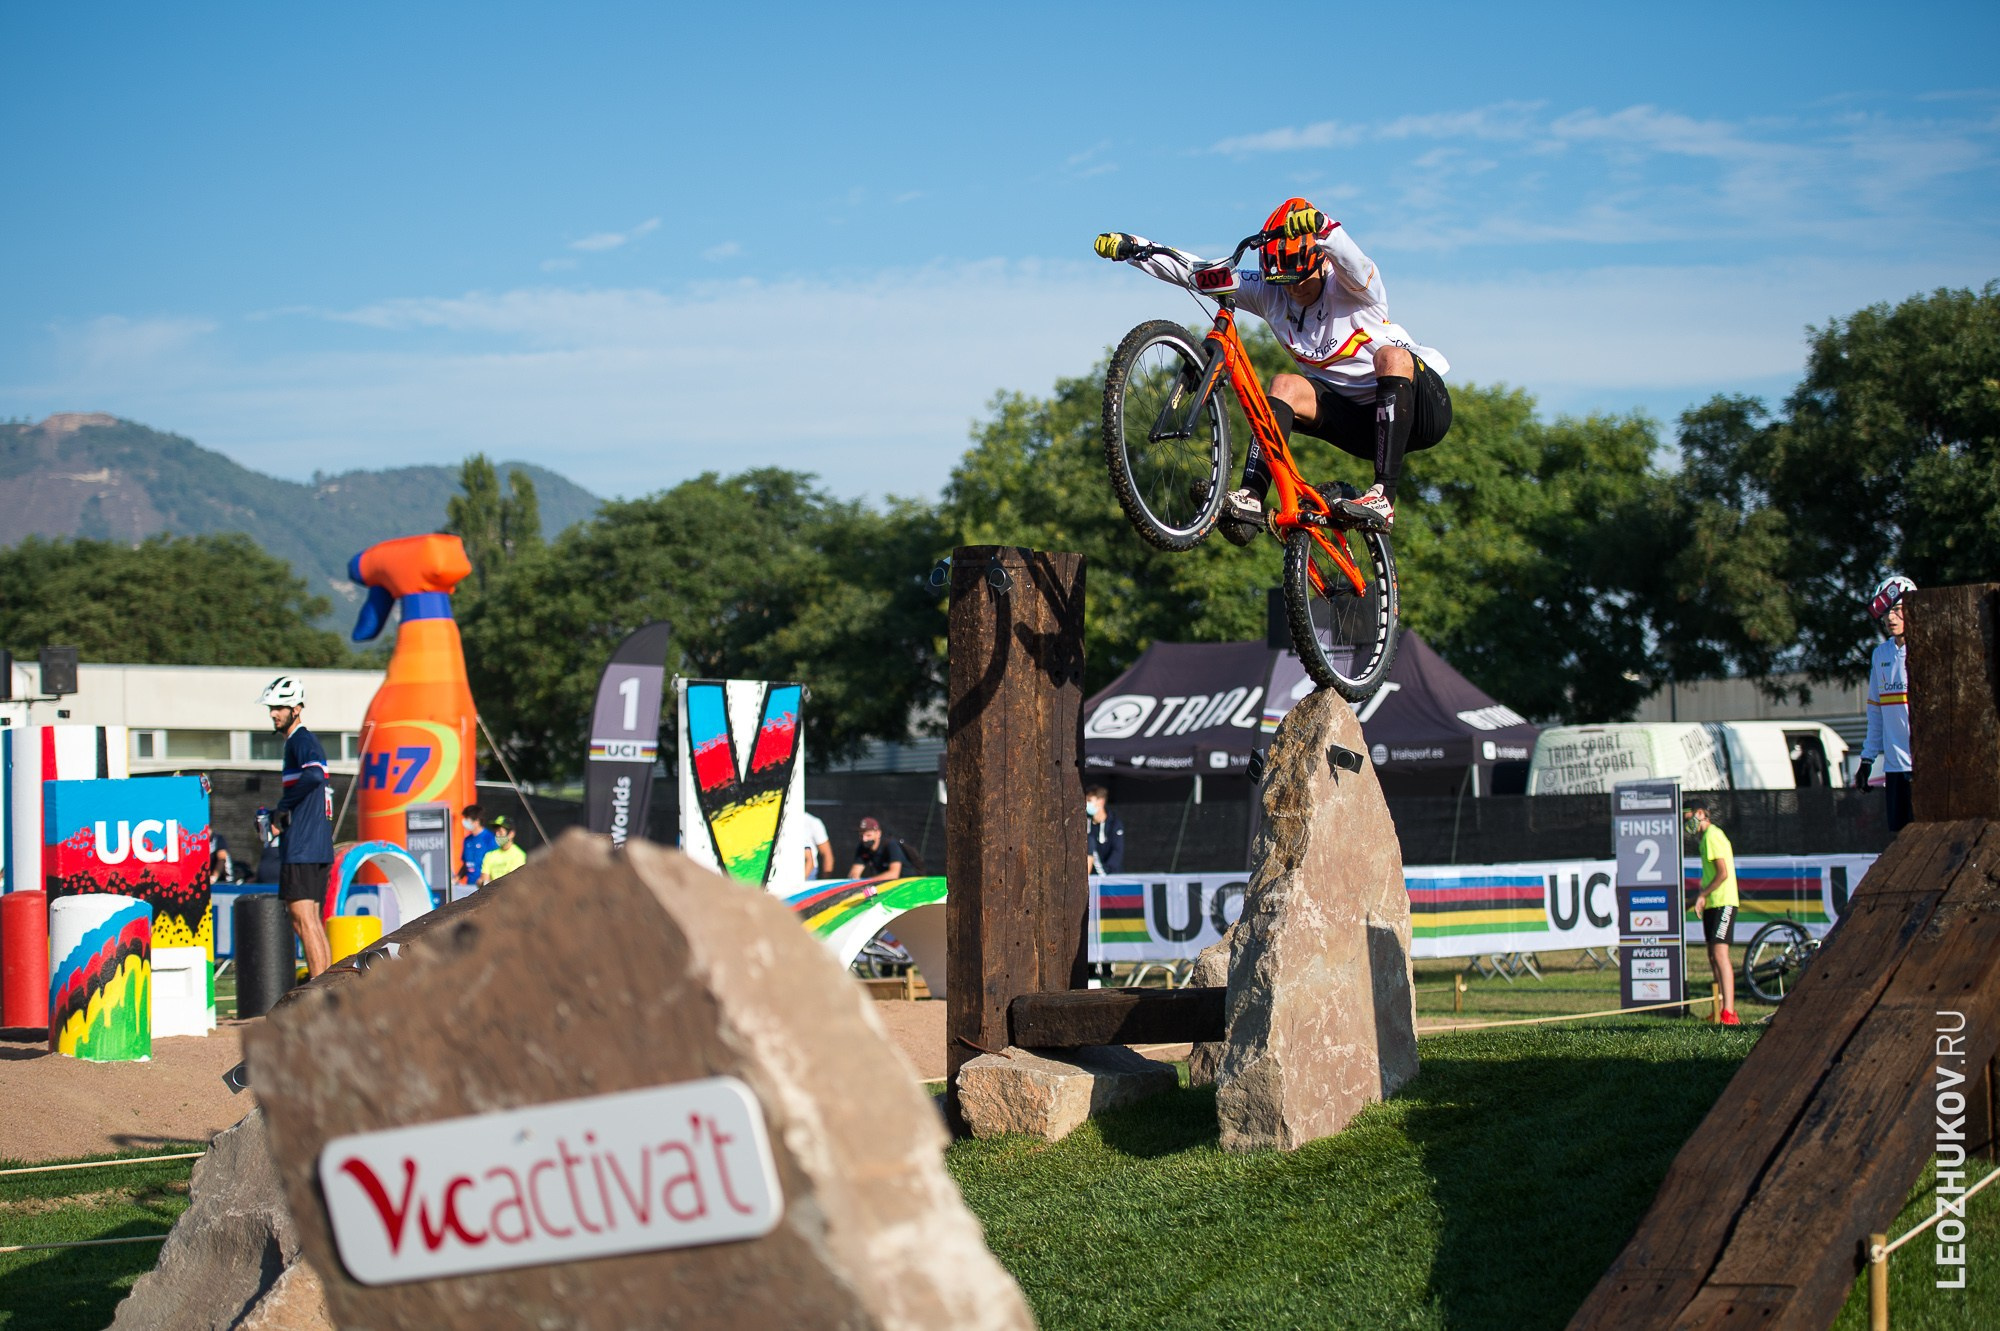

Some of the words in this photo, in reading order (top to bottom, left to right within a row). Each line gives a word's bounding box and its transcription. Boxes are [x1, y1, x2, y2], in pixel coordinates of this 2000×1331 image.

[1198, 269, 1228, 287] 207
[618, 677, 640, 731] 1
[606, 744, 637, 757] UCI
[1549, 731, 1620, 766] TRIALSPORT
[1560, 751, 1635, 783] TRIALSPORT
[1619, 820, 1674, 837] FINISH
[94, 818, 180, 865] UCI
[408, 835, 445, 851] FINISH
[420, 852, 432, 891] 1
[1635, 839, 1663, 882] 2
[1153, 881, 1247, 942] UC
[1548, 872, 1613, 931] UC
[1631, 895, 1667, 905] SHIMANO
[1632, 948, 1668, 958] #Vic2021
[1642, 937, 1657, 945] UCI
[1637, 967, 1665, 975] TISSOT
